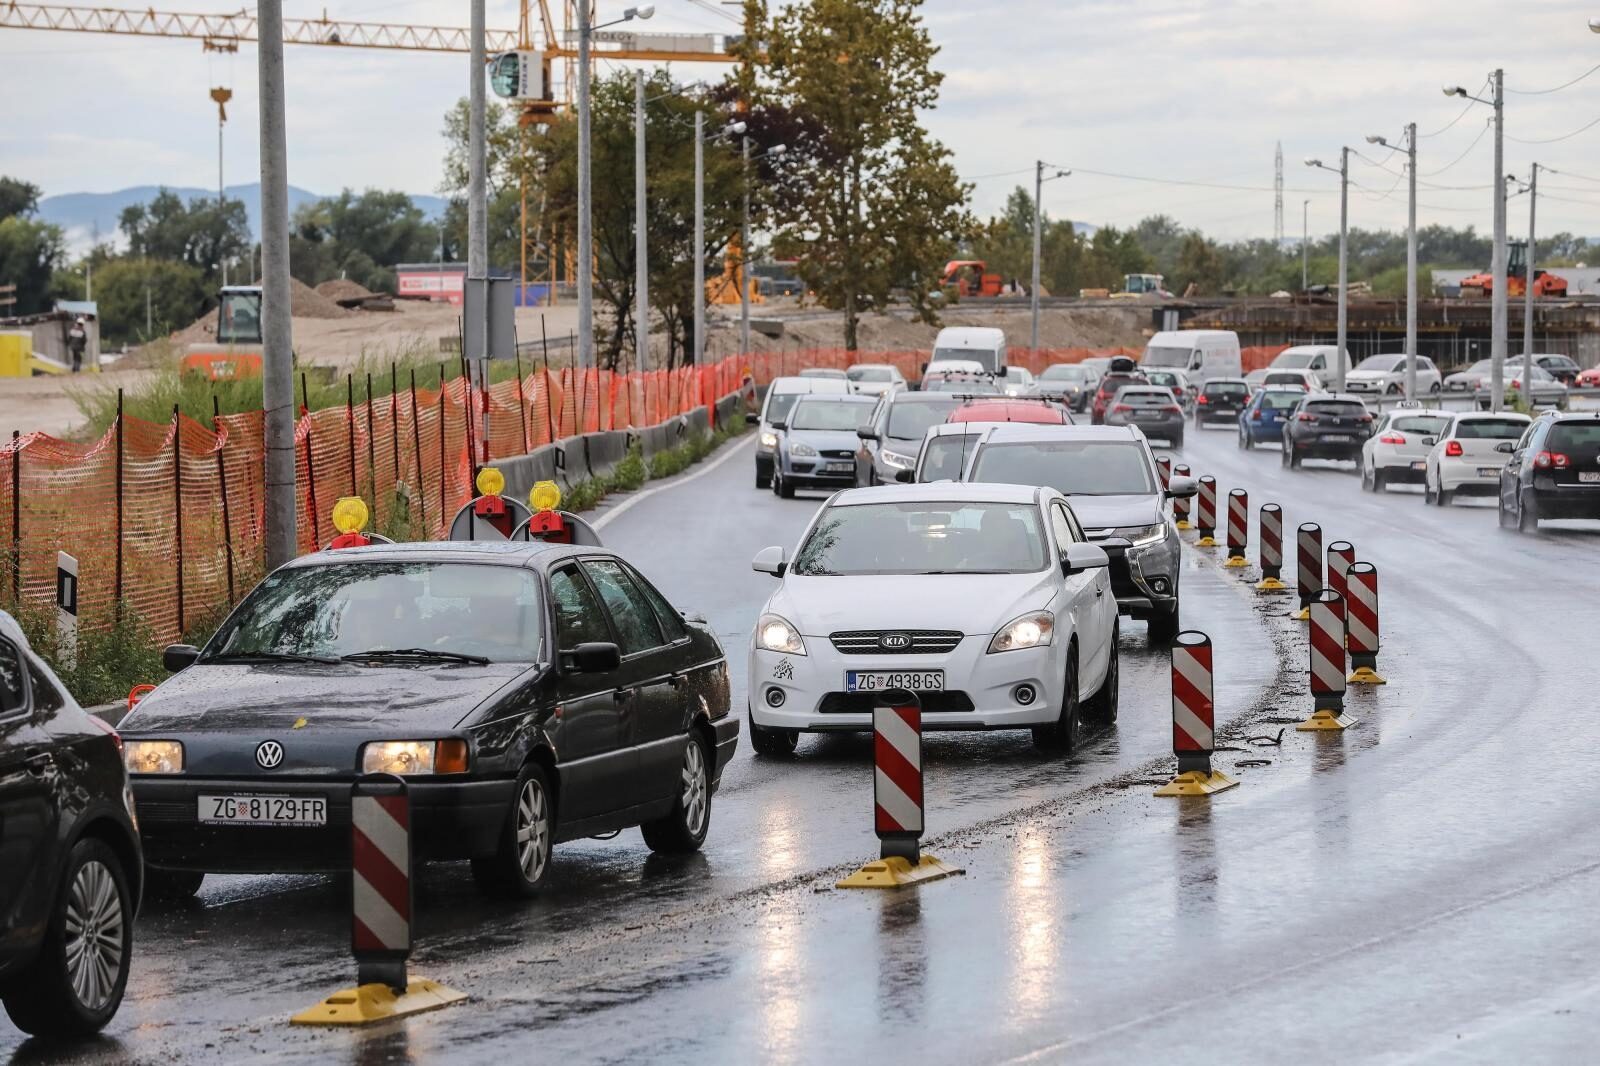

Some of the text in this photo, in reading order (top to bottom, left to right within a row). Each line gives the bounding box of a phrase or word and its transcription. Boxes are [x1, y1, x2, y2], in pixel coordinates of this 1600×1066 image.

[886, 637, 905, 645] KIA
[857, 674, 876, 690] ZG
[212, 798, 236, 819] ZG
